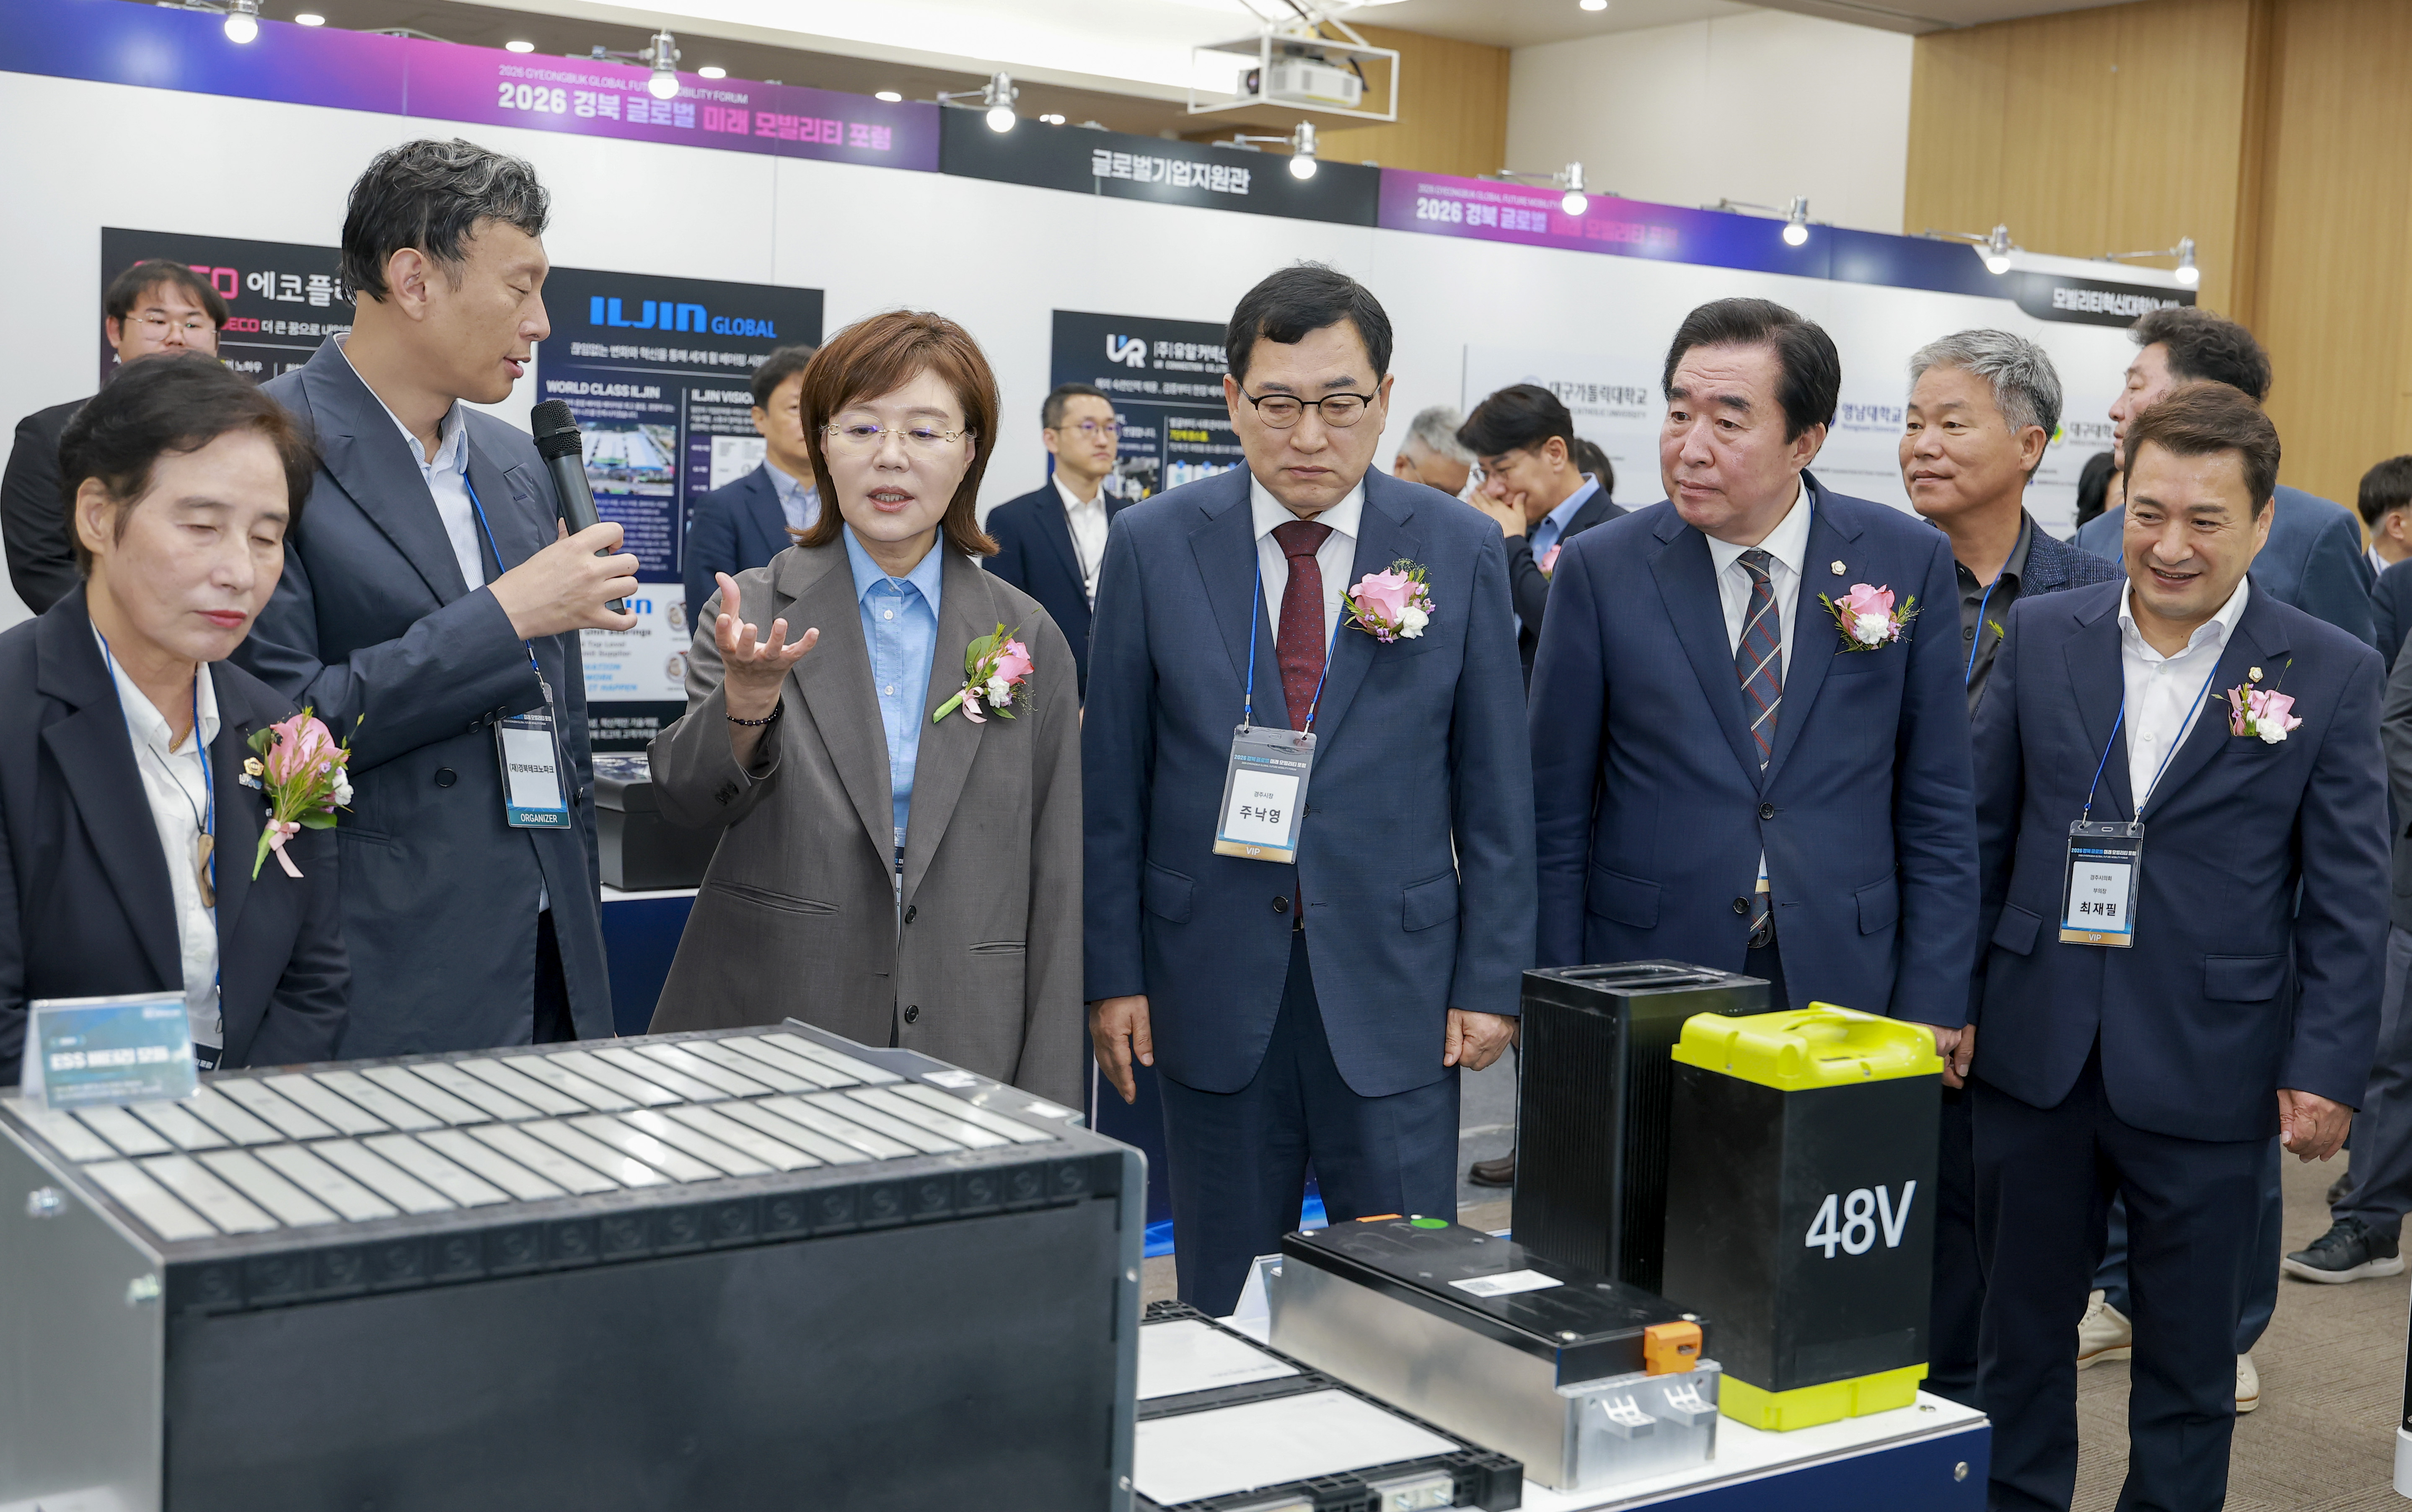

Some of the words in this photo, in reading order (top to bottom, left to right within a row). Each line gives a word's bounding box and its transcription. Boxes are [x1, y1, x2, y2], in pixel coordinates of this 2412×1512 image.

[676, 85, 712, 100] OBILITY
[713, 90, 749, 105] FORUM
[498, 81, 567, 114] 2026
[573, 90, 621, 121] 경북
[626, 96, 696, 129] 글로벌
[703, 106, 750, 135] 미래
[755, 111, 843, 145] 모빌리티
[849, 123, 892, 151] 포럼
[1092, 148, 1251, 195] 글로벌기업지원관
[1416, 197, 1463, 224] 2026
[1465, 202, 1498, 227] 경북
[1500, 207, 1547, 233] 글로벌
[221, 317, 261, 333] ECO
[261, 319, 273, 334] 더
[274, 320, 287, 335] 큰
[287, 321, 321, 336] 꿈으로
[590, 296, 707, 333] ILJIN
[712, 316, 777, 339] GLOBAL
[546, 380, 589, 396] WORLD
[590, 382, 630, 398] CLASS
[720, 390, 755, 405] VISIO
[1549, 381, 1647, 405] 대구가톨릭대학교
[1843, 403, 1901, 422] 영남대학교
[2070, 421, 2112, 438] 대구대학
[509, 763, 554, 774] (재)경북테크노파크
[520, 813, 558, 823] ORGANIZER
[1240, 805, 1281, 823] 주낙영
[1246, 846, 1260, 856] VIP
[2080, 902, 2116, 916] 최재필
[2089, 933, 2101, 942] VIP
[49, 1052, 87, 1071] ESS
[1805, 1179, 1917, 1259] 48V
